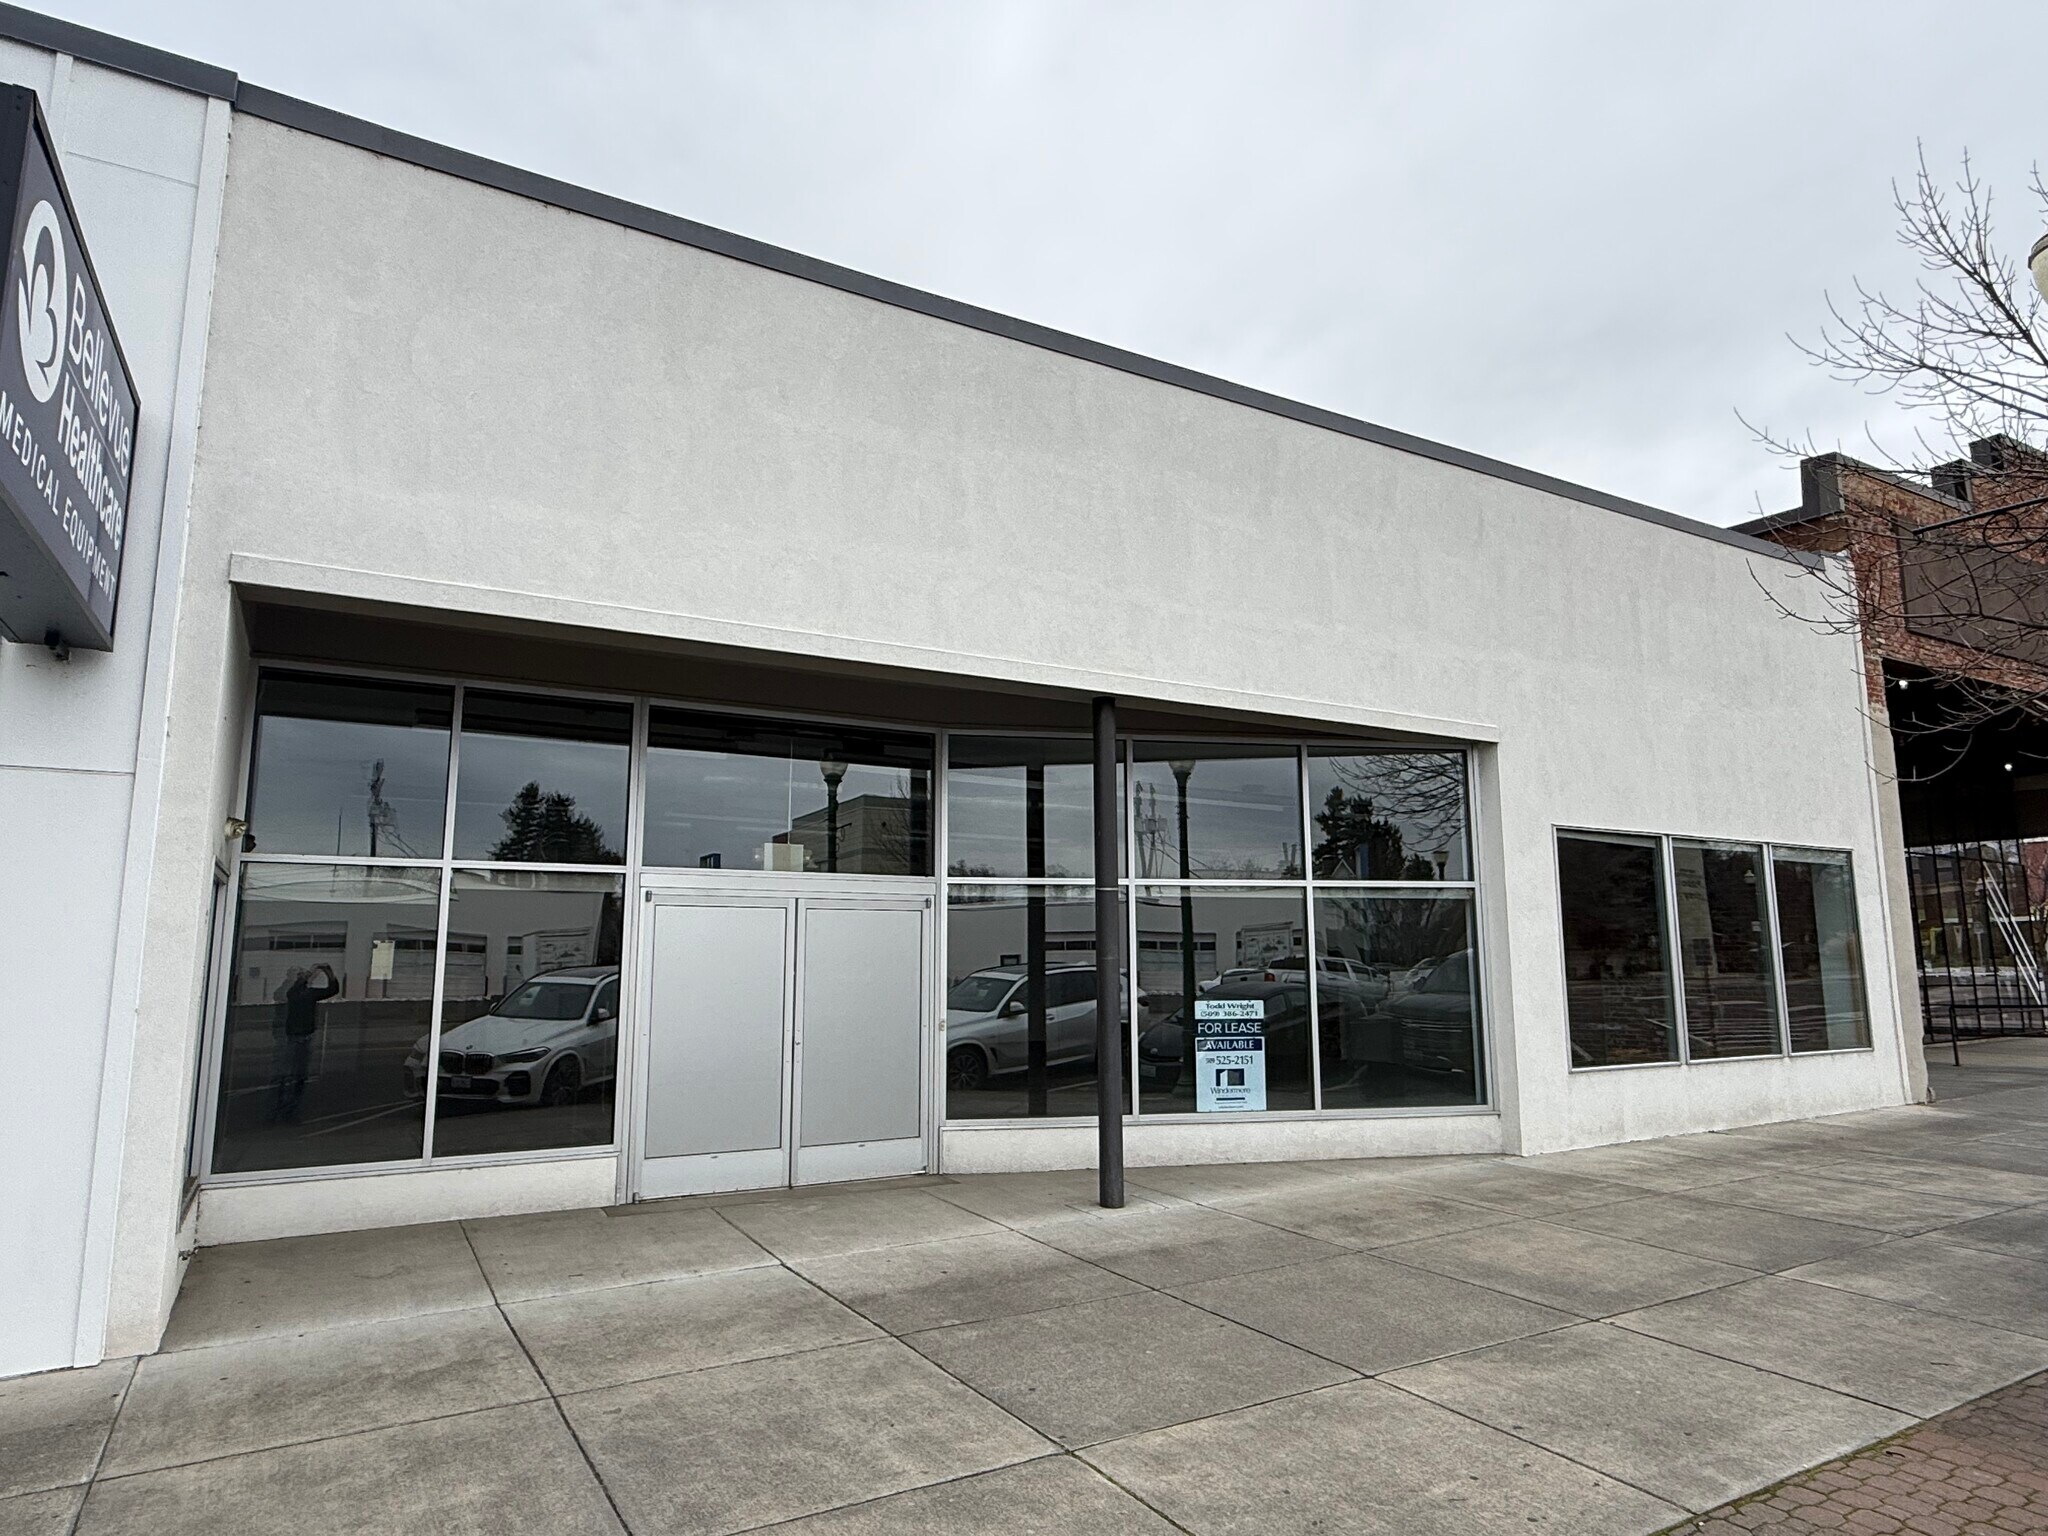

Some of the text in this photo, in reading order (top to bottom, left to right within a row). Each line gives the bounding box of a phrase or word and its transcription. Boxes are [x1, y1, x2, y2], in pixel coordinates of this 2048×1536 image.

[69, 273, 130, 477] Bellevue
[0, 390, 116, 602] MEDICAL EQUIPMENT
[58, 372, 122, 550] Healthcare
[1198, 1022, 1262, 1034] FOR LEASE
[1206, 1040, 1255, 1050] AVAILABLE
[1216, 1055, 1253, 1065] 525-2151
